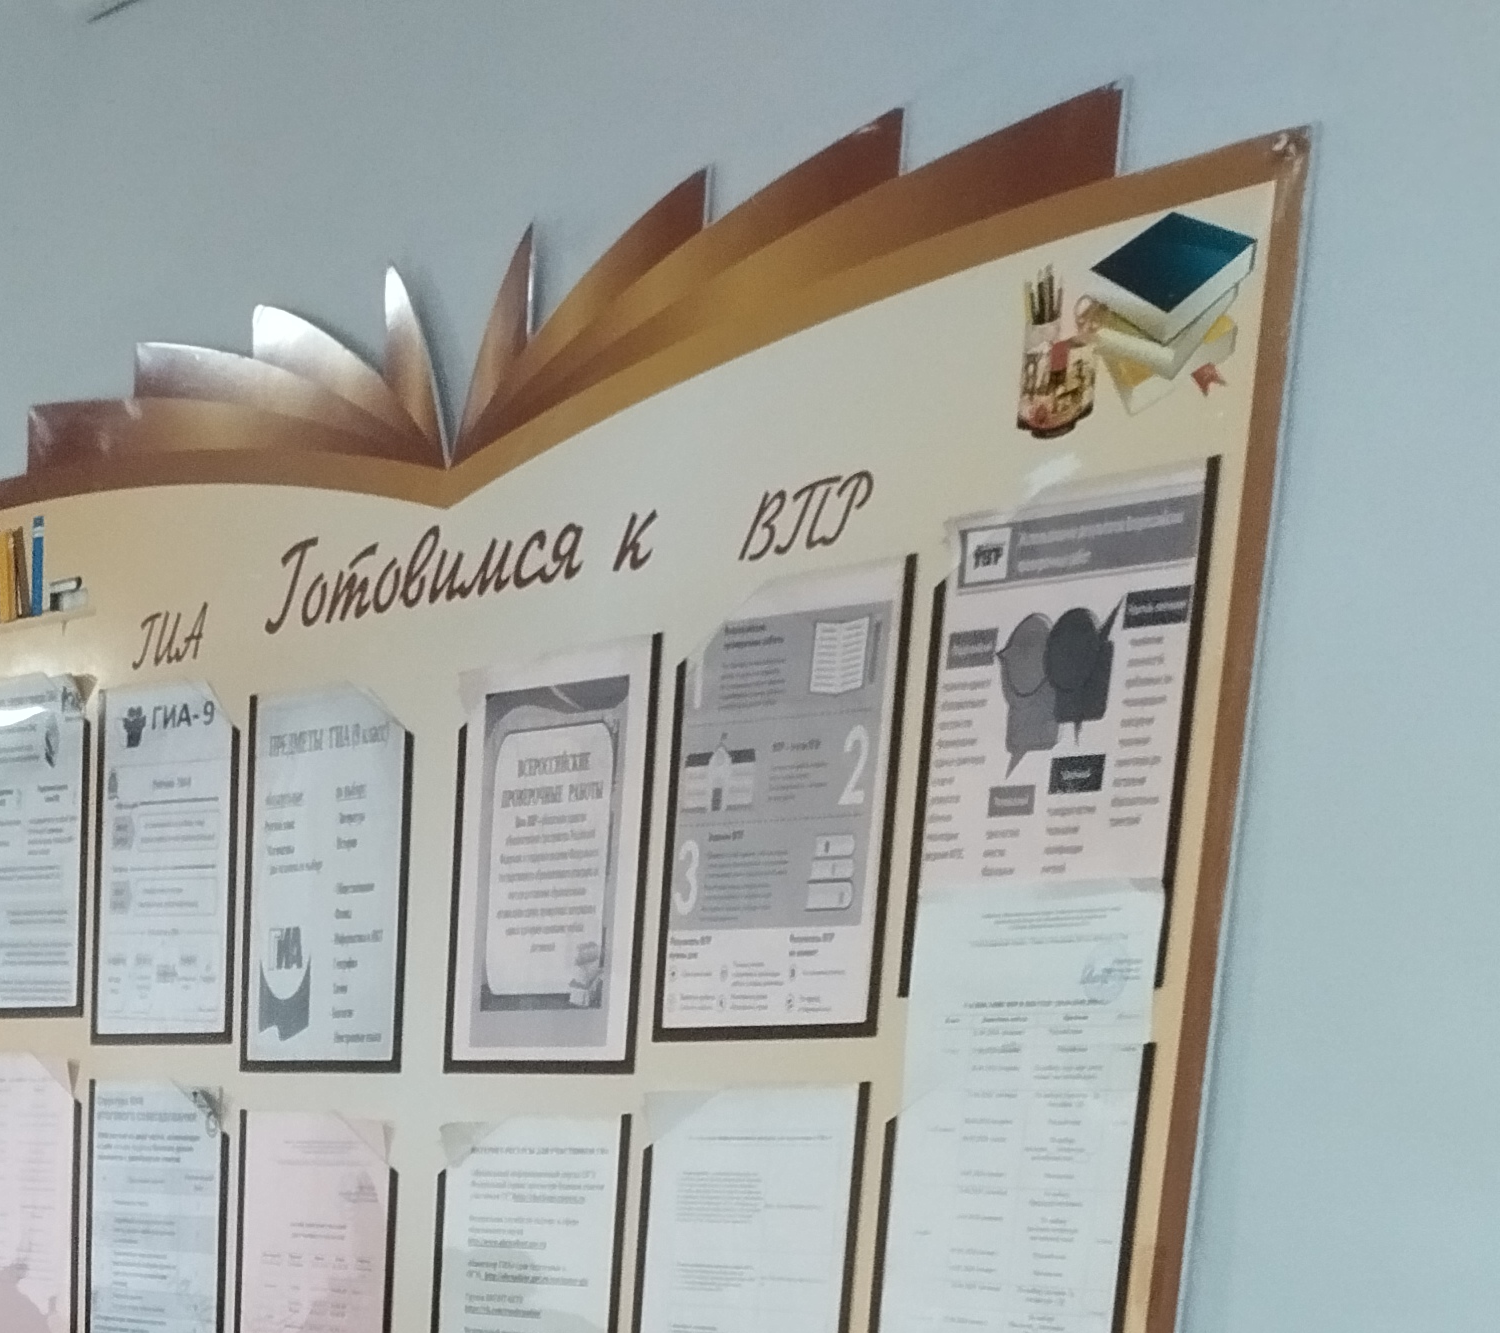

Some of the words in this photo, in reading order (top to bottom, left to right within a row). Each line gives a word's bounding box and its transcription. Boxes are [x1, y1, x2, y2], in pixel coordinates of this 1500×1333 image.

[264, 523, 584, 636] Готовимся
[613, 508, 657, 573] к
[737, 469, 875, 562] ВПР
[131, 601, 209, 672] ГИА
[150, 700, 216, 731] ГИА-9
[838, 724, 870, 806] 2
[674, 839, 700, 915] 3
